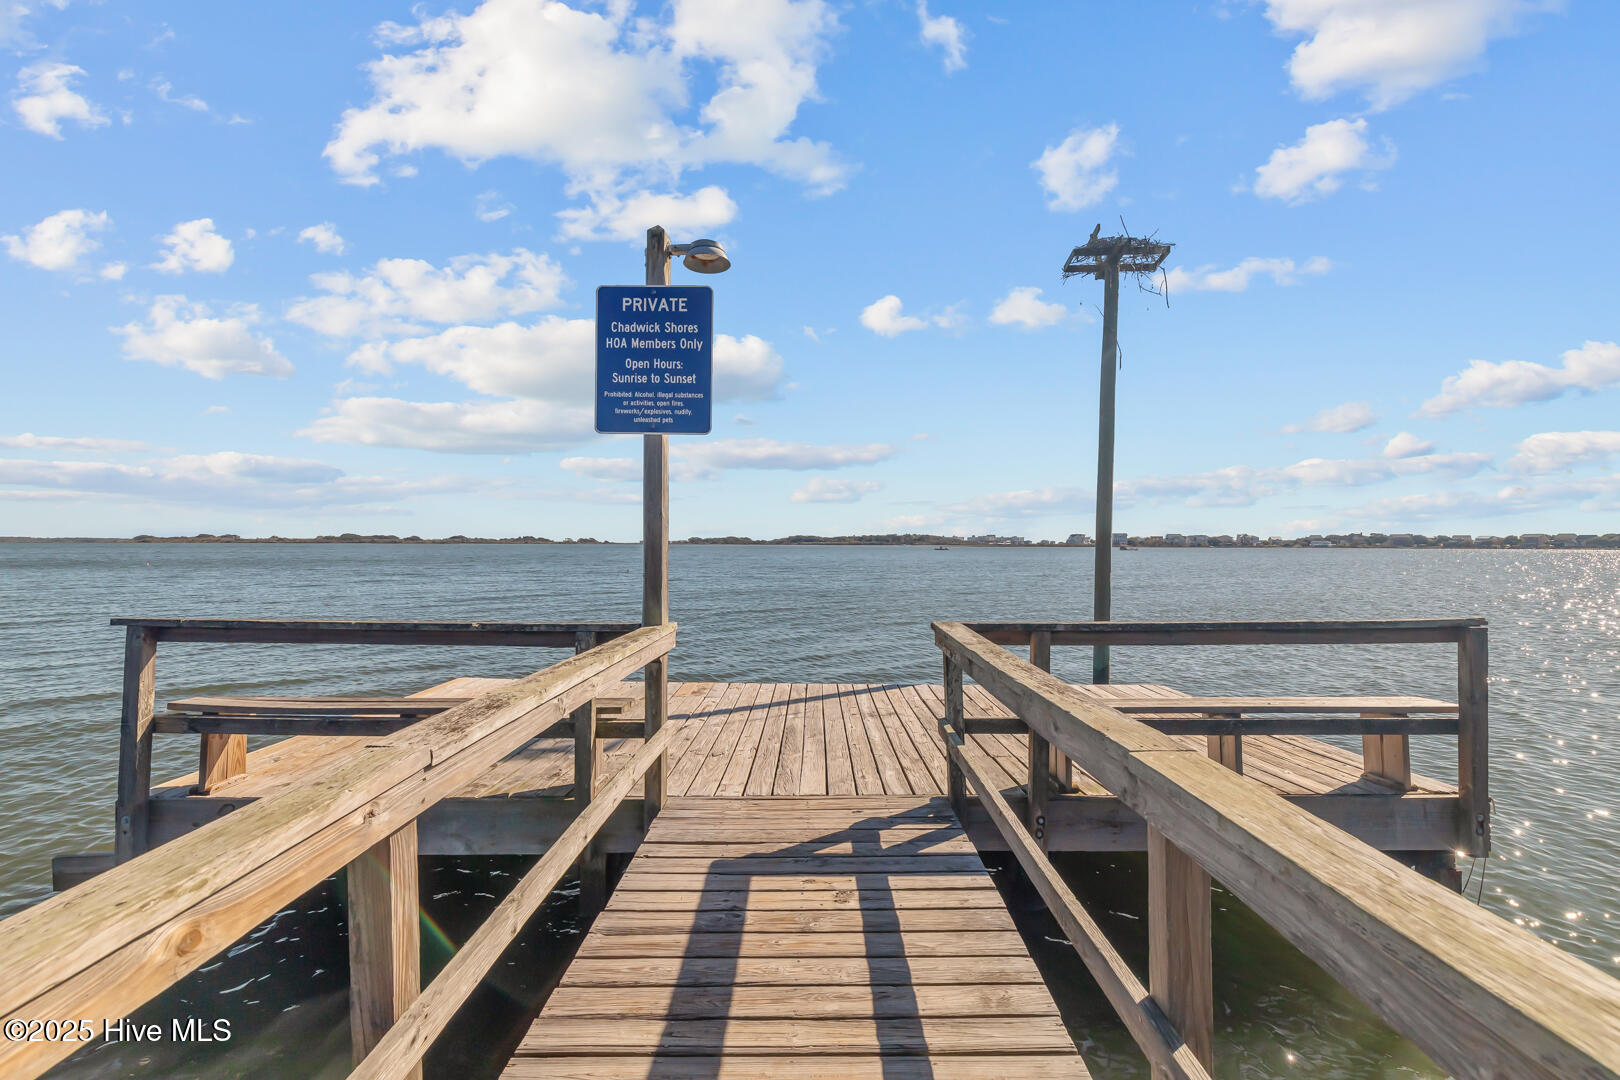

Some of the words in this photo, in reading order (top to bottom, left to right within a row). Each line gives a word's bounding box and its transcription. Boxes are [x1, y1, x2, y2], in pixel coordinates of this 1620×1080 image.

[622, 297, 688, 312] PRIVATE
[611, 321, 661, 333] Chadwick
[664, 322, 699, 333] Shores
[606, 337, 627, 349] HOA
[631, 338, 676, 349] Members
[680, 338, 703, 352] Only
[625, 358, 650, 371] Open
[653, 358, 684, 369] Hours:
[612, 372, 648, 383] Sunrise
[650, 373, 661, 384] to
[664, 373, 696, 384] Sunset
[674, 391, 704, 399] substances
[662, 416, 674, 424] pets
